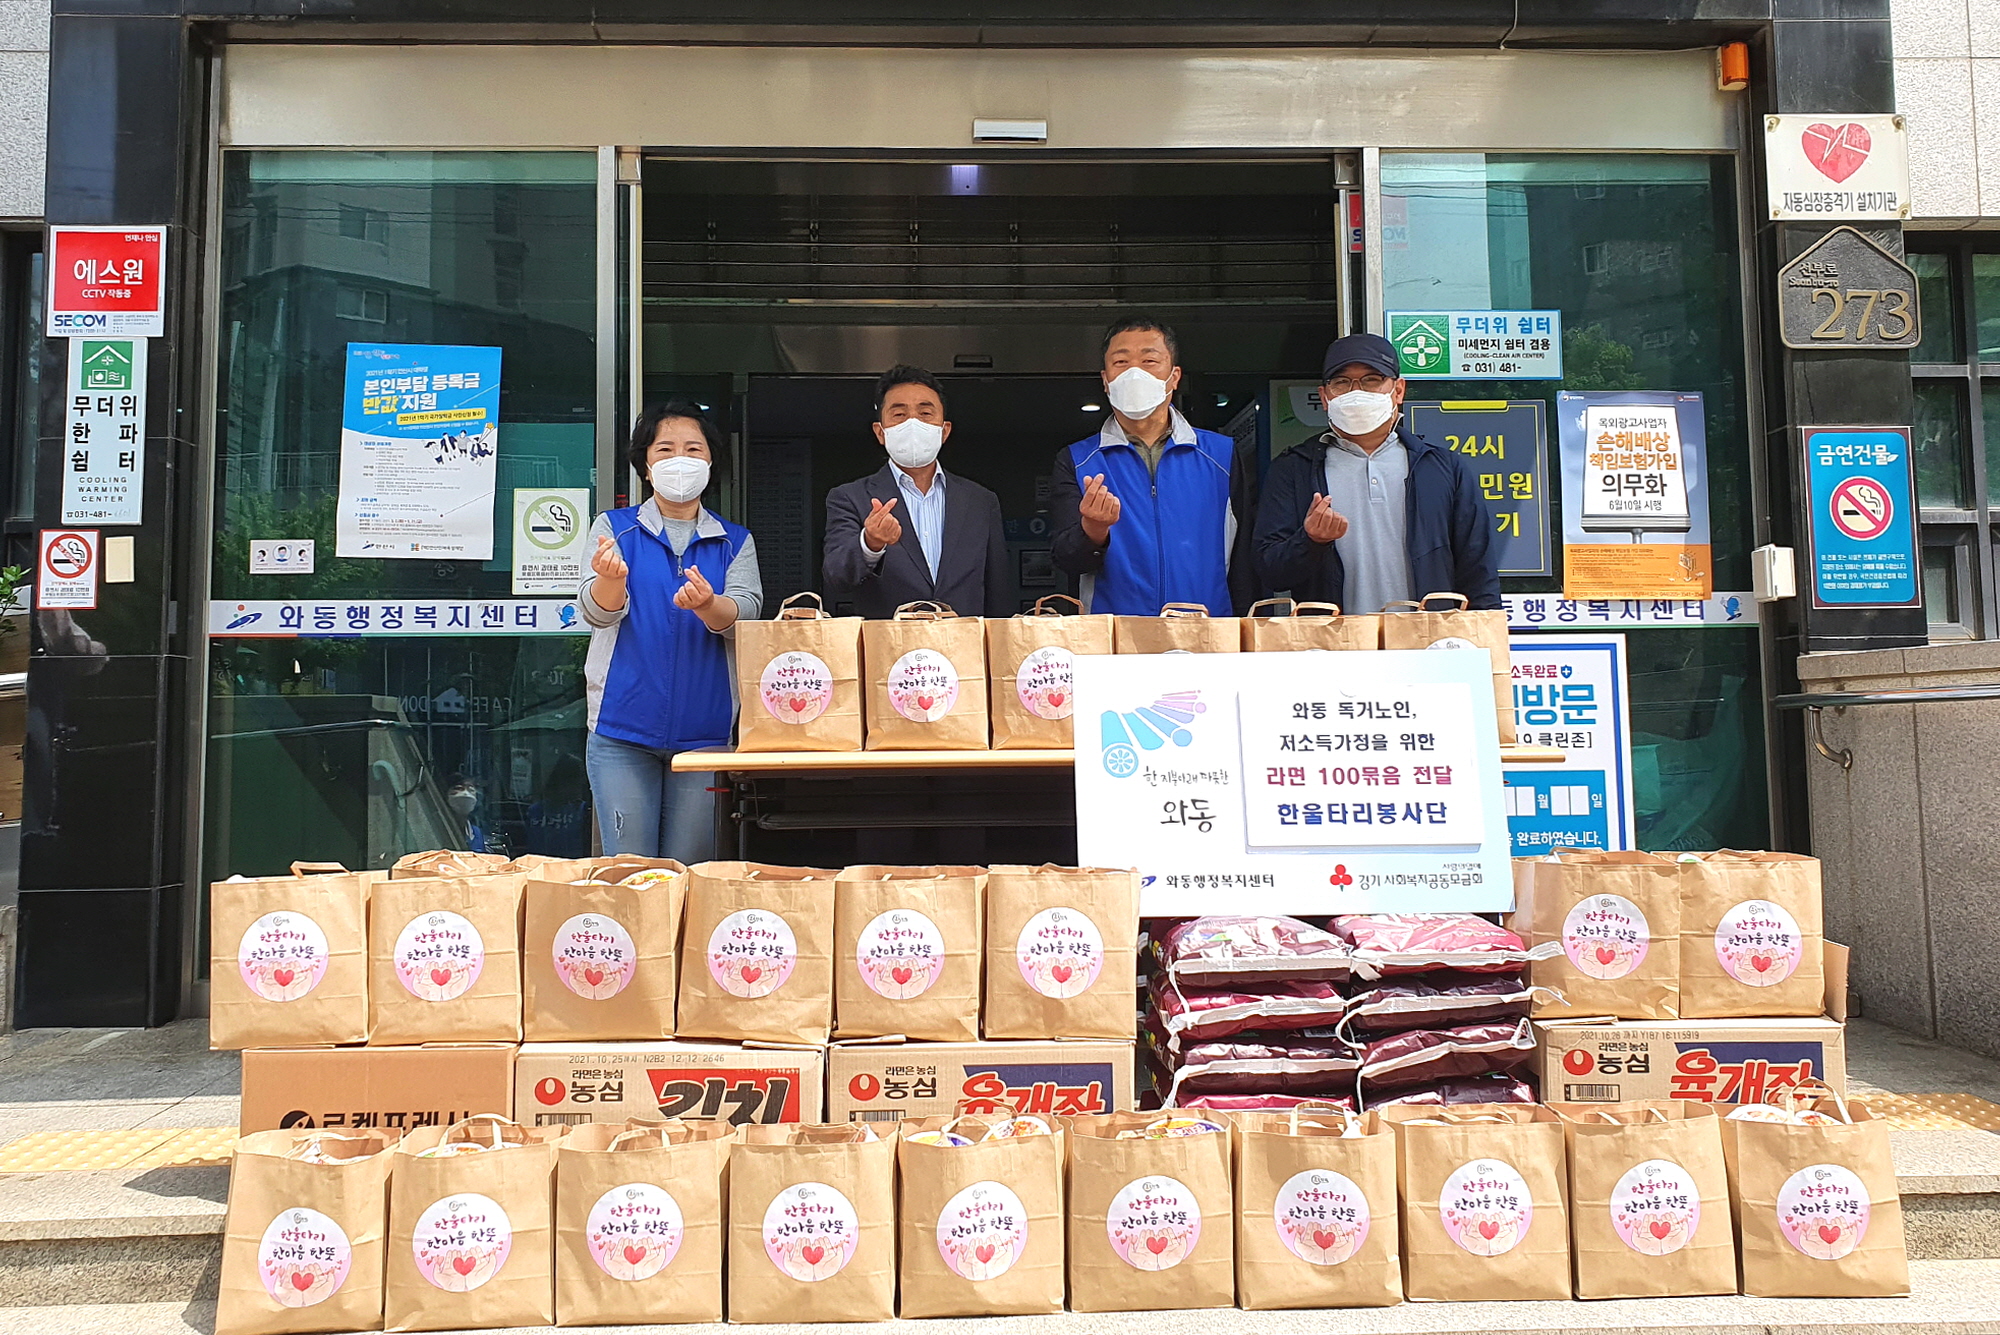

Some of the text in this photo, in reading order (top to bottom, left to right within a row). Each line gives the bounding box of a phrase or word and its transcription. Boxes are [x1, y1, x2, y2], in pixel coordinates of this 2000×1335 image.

[1783, 192, 1897, 213] 자동심장충격기 설치기관
[74, 259, 143, 285] 에스원
[82, 289, 131, 298] CCTV 작동중
[55, 315, 106, 327] SECOM
[1811, 289, 1913, 340] 273
[1456, 317, 1550, 334] 무더위 쉼터
[1458, 338, 1550, 350] 미세먼지 쉼터 겸용
[1475, 362, 1522, 374] 031) 481-
[363, 372, 480, 396] 본인부담 등록금
[402, 393, 437, 410] 지원
[1599, 418, 1667, 429] 옥외광고사업자
[1445, 435, 1504, 460] 24시
[1596, 432, 1670, 452] 손해배상
[1589, 453, 1677, 470] 책임보험가입
[1817, 445, 1890, 465] 금연건물
[1602, 473, 1668, 496] 의무화
[1644, 500, 1662, 511] 시행
[1496, 512, 1520, 537] 기
[279, 605, 538, 629] 와동행정복지센터
[777, 663, 815, 677] 한울타리
[904, 663, 940, 676] 한울타리
[1511, 665, 1557, 678] 소독완료
[770, 678, 800, 690] 한마음
[898, 676, 926, 689] 한마음
[1293, 701, 1416, 719] 와동 독거노인,
[1280, 733, 1435, 752] 저소득가정을 위한
[1267, 766, 1452, 786] 라면 100묶음 전달
[1537, 793, 1603, 809] 월 일
[1160, 799, 1216, 833] 와동
[1278, 802, 1447, 825] 한울타리봉사단
[1517, 831, 1602, 846] 완료하였습니다.
[1166, 875, 1274, 888] 와동행정복지센터
[1358, 873, 1483, 890] 경기 사회복지공동모금회
[1586, 910, 1630, 924] 한울타리
[1736, 918, 1781, 930] 한울타리
[261, 929, 306, 942] 한울타리
[415, 929, 461, 942] 한울타리
[572, 930, 614, 944] 한울타리
[732, 926, 776, 940] 한울타리
[878, 927, 923, 940] 한울타리
[1038, 925, 1082, 938] 한울타리
[1576, 924, 1610, 937] 한마음
[1728, 932, 1764, 946] 한마음
[251, 944, 286, 960] 한마음
[407, 944, 443, 960] 한마음
[564, 946, 596, 958] 한마음
[722, 942, 757, 956] 한마음
[870, 942, 904, 957] 한마음
[1030, 940, 1064, 955] 한마음
[1599, 1042, 1648, 1051] 라면은 농심
[644, 1055, 665, 1063] N2B2
[703, 1054, 724, 1062] 2646
[1597, 1053, 1650, 1074] 농심
[572, 1069, 623, 1078] 라면은 농심
[885, 1066, 936, 1075] 라면은 농심
[570, 1081, 624, 1103] 농심
[884, 1077, 937, 1098] 농심
[1462, 1178, 1508, 1192] 한울타리
[1632, 1180, 1678, 1194] 한울타리
[1800, 1184, 1848, 1197] 한울타리
[1297, 1188, 1346, 1202] 한울타리
[1454, 1194, 1490, 1210] 한마음
[611, 1202, 660, 1216] 한울타리
[785, 1202, 834, 1216] 한울타리
[959, 1202, 1003, 1218] 한울타리
[1129, 1196, 1177, 1210] 한울타리
[1625, 1196, 1660, 1213] 한마음
[1792, 1200, 1830, 1216] 한마음
[1122, 1210, 1158, 1228] 한마음
[1288, 1204, 1326, 1220] 한마음
[435, 1214, 485, 1230] 한울타리
[601, 1220, 639, 1235] 한마음
[777, 1218, 814, 1236] 한마음
[951, 1218, 986, 1238] 한마음
[281, 1227, 325, 1242] 한울타리
[427, 1230, 466, 1249] 한마음
[273, 1245, 305, 1260] 한마음
